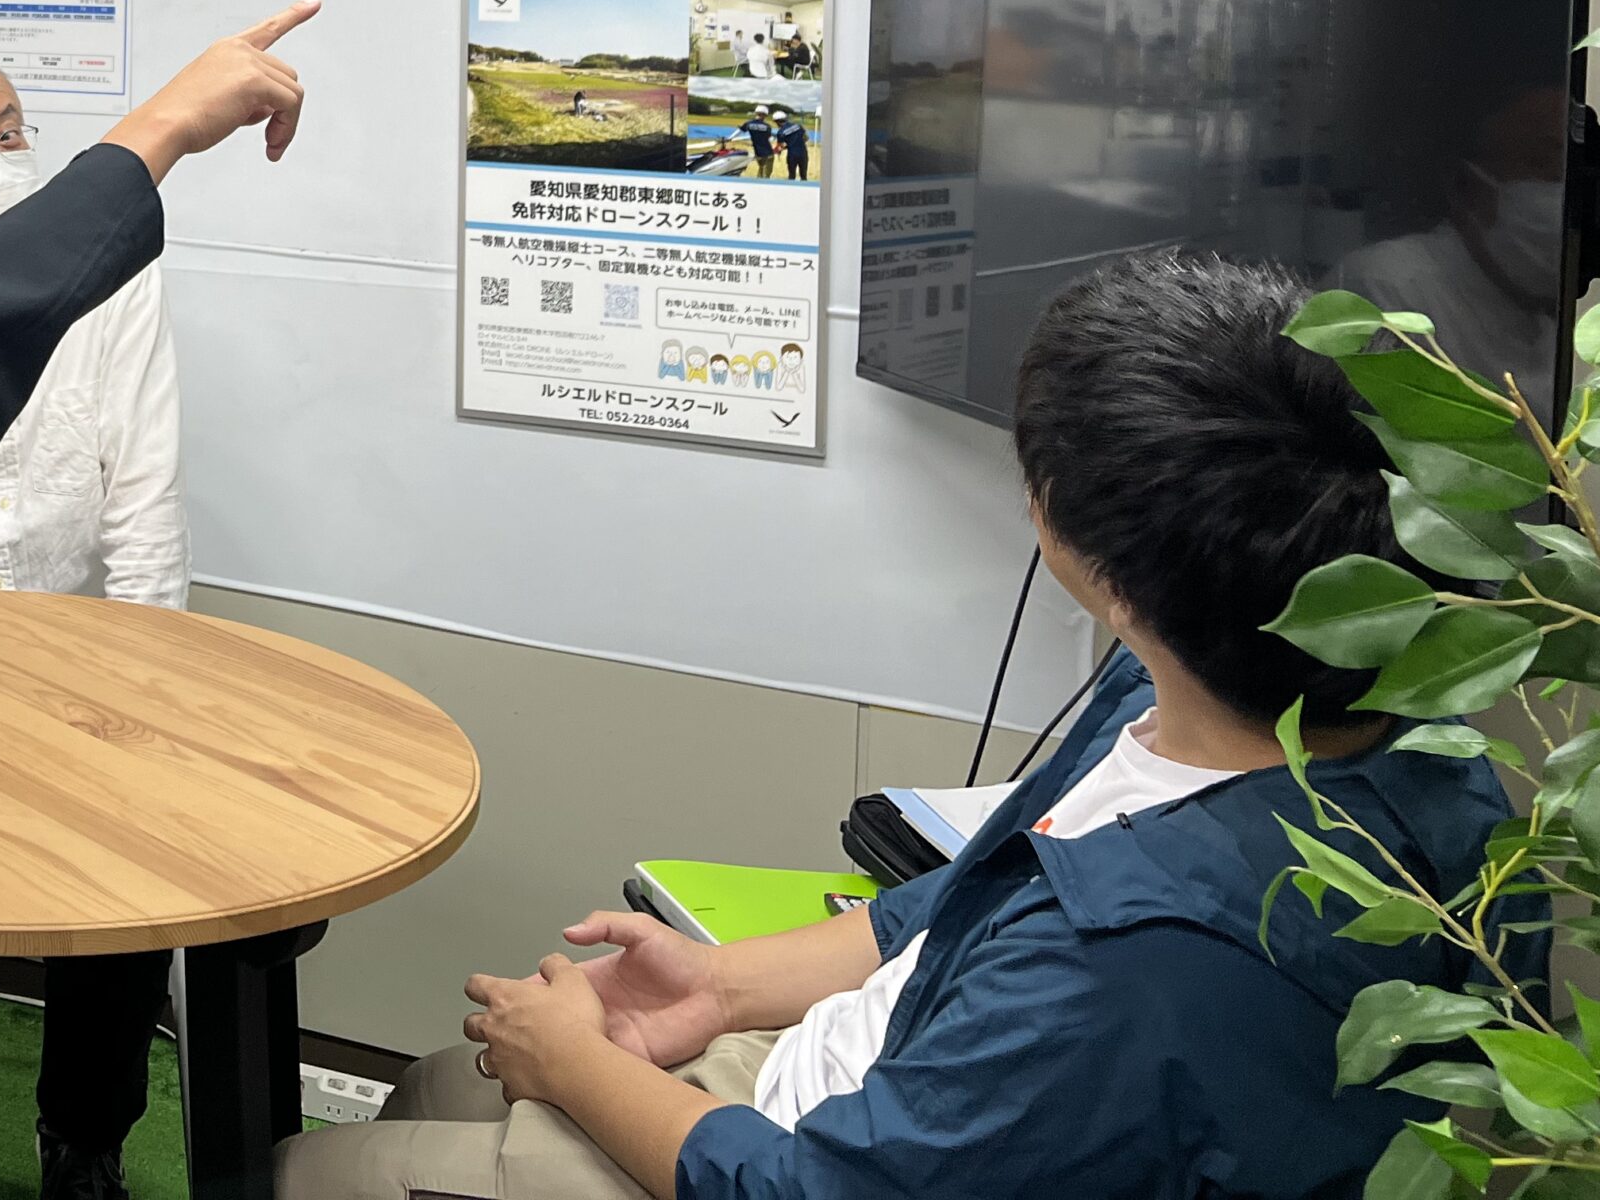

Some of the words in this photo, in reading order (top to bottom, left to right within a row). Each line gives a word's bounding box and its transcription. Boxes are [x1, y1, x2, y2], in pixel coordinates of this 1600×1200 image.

[530, 179, 748, 210] 愛知県愛知郡東郷町にある
[512, 202, 762, 233] 免許対応ドローンスクール！！
[469, 235, 815, 272] 一等無人航空機操縦士コース、二等無人航空機操縦士コース
[541, 383, 728, 416] ルシエルドローンスクール
[579, 408, 603, 420] TEL:
[606, 410, 690, 429] 052-228-0364
